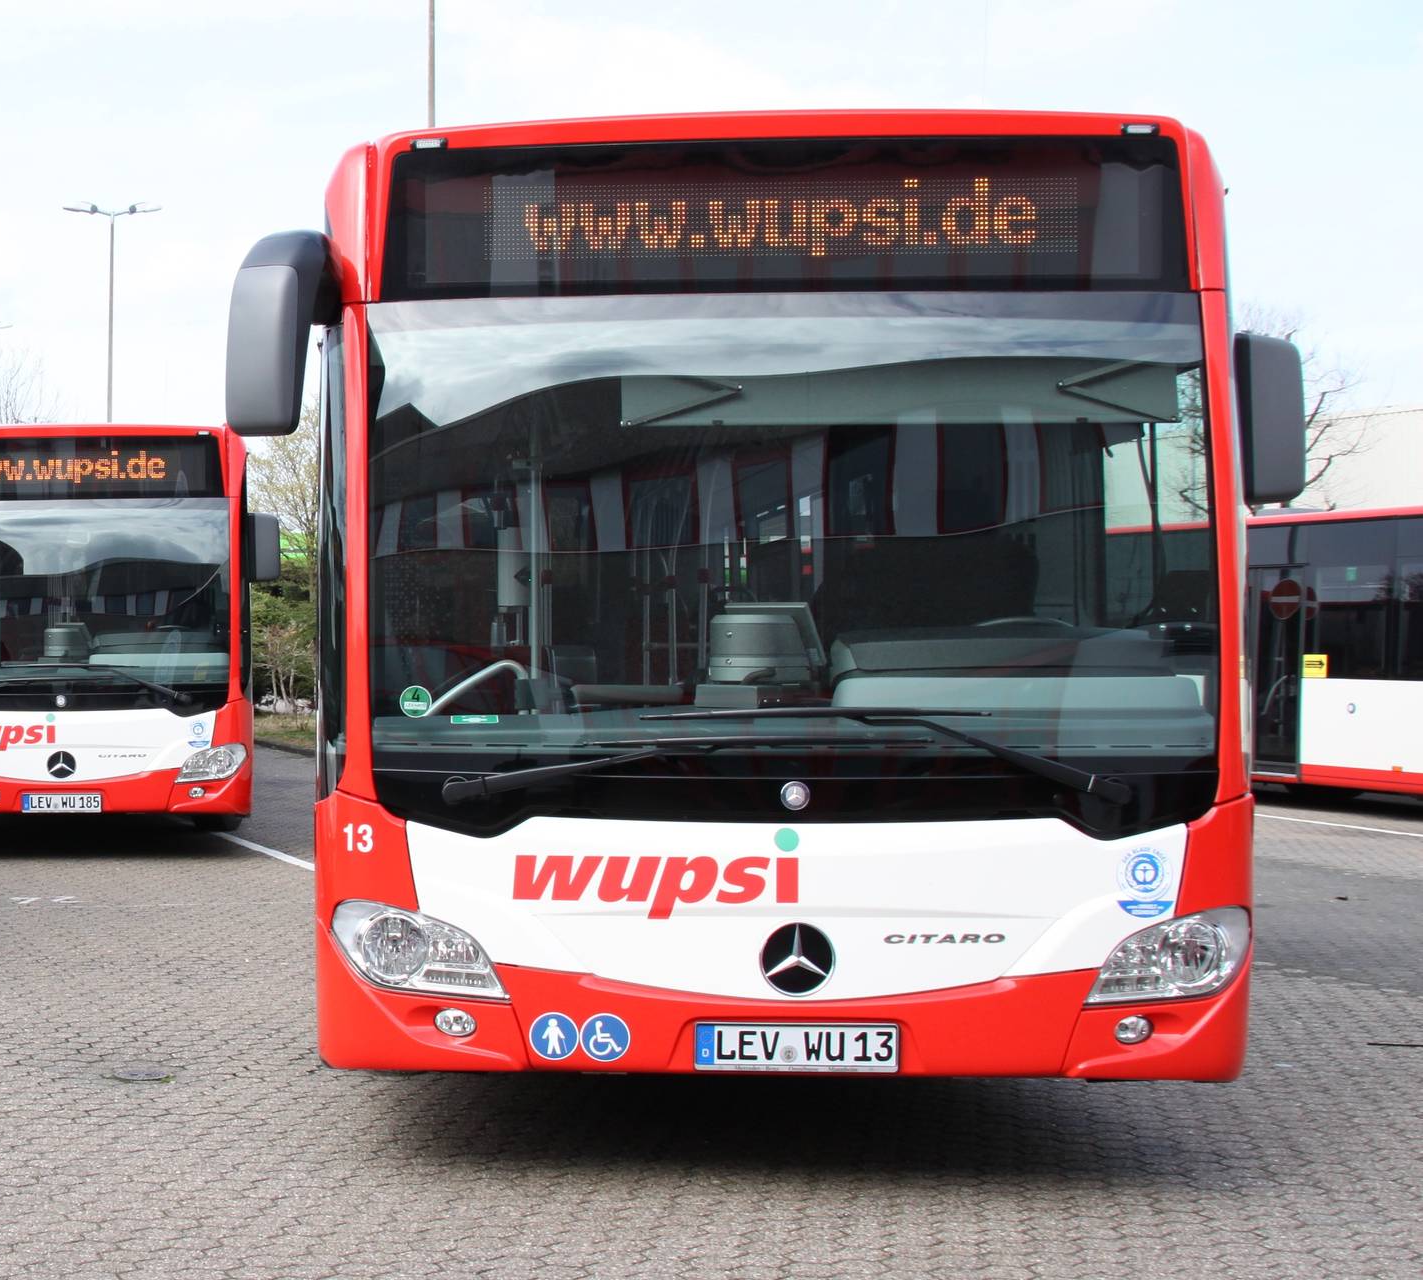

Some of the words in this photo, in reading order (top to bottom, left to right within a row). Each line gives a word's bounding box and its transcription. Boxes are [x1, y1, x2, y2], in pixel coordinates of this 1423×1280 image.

[523, 177, 1037, 256] www.wupsi.de
[411, 688, 420, 701] 4
[30, 796, 52, 809] LEV
[61, 796, 76, 809] WU
[79, 796, 100, 809] 185
[343, 823, 374, 853] 13
[512, 827, 800, 920] wupsi
[883, 933, 1006, 945] CITARO
[701, 1048, 709, 1057] D
[716, 1030, 780, 1061] LEV
[803, 1031, 845, 1062] WU
[854, 1031, 894, 1062] 13
